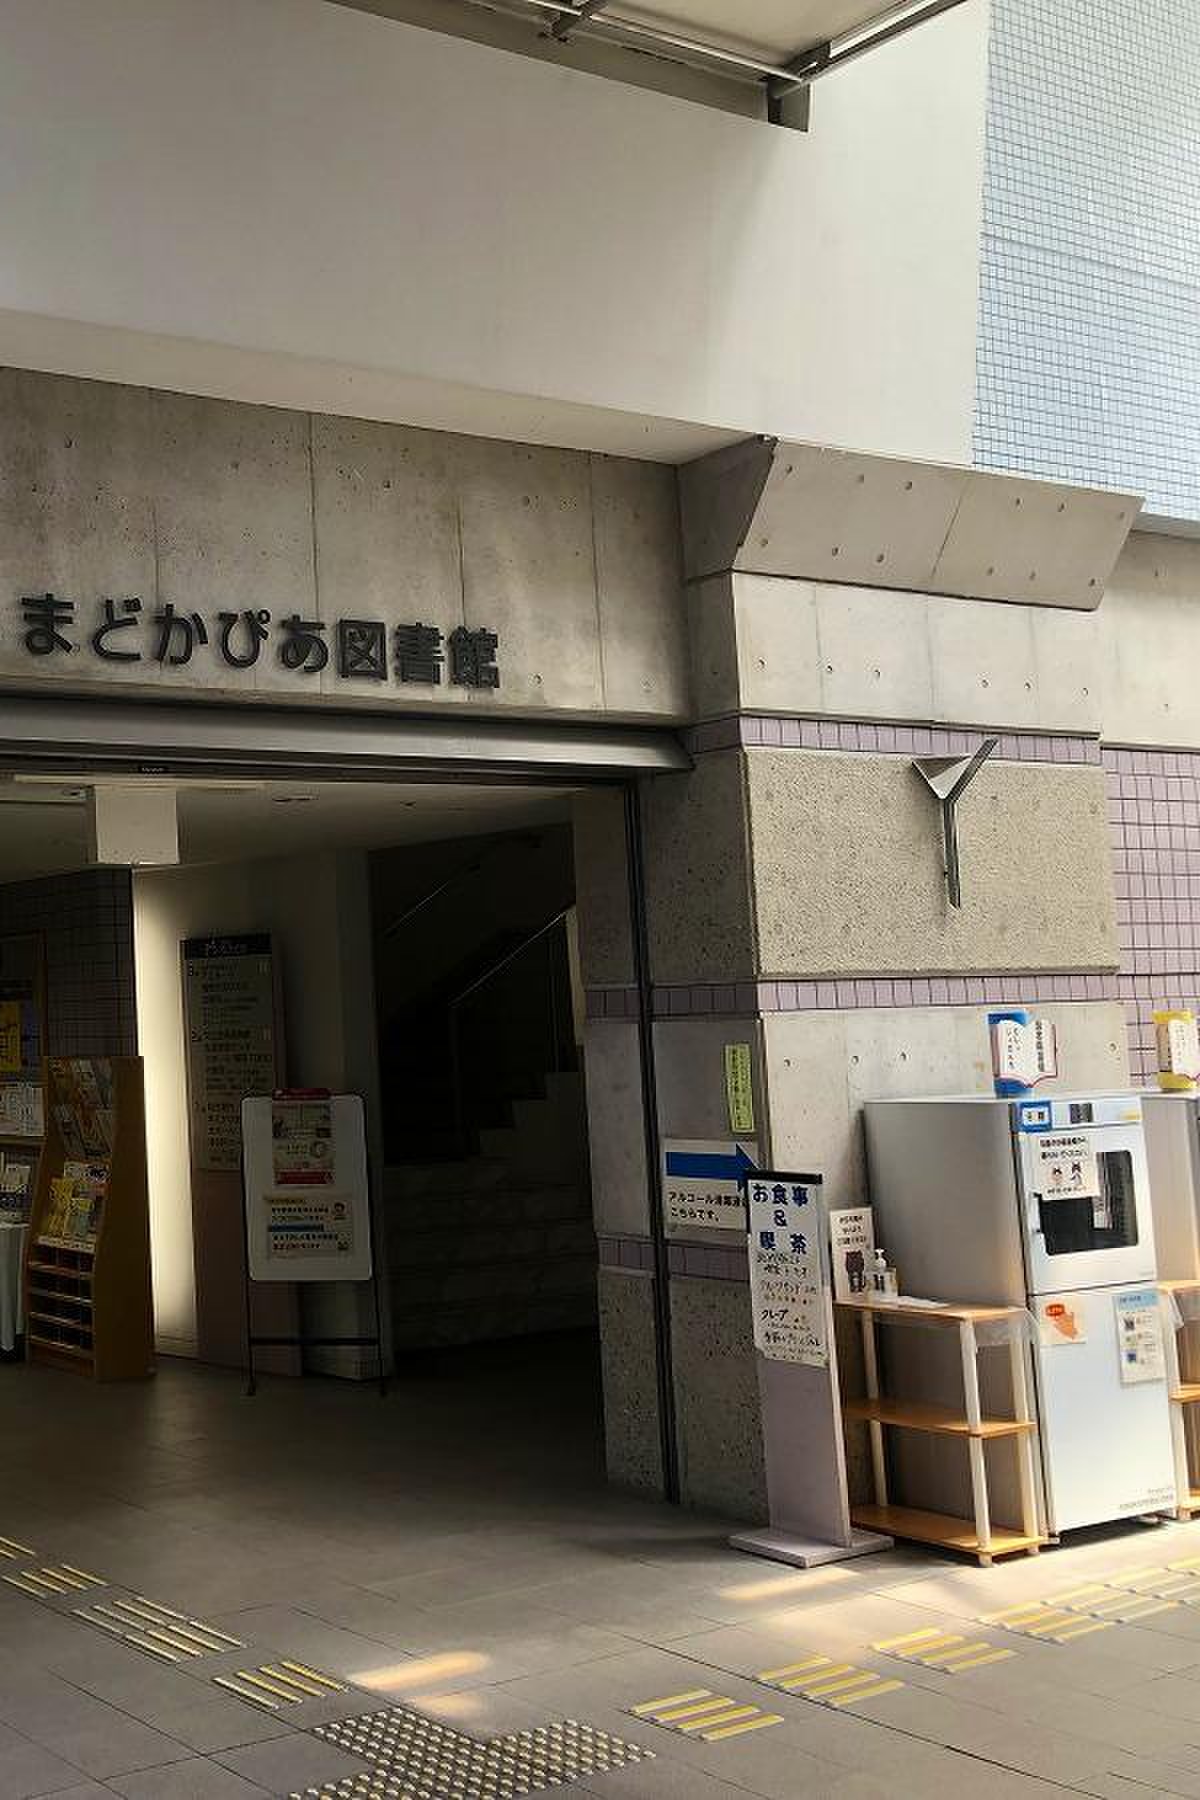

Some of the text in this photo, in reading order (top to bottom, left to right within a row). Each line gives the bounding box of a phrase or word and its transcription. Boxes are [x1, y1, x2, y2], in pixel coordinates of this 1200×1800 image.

[20, 593, 500, 689] まどかぴあ図書館
[752, 1183, 809, 1207] お食事
[773, 1209, 788, 1227] &
